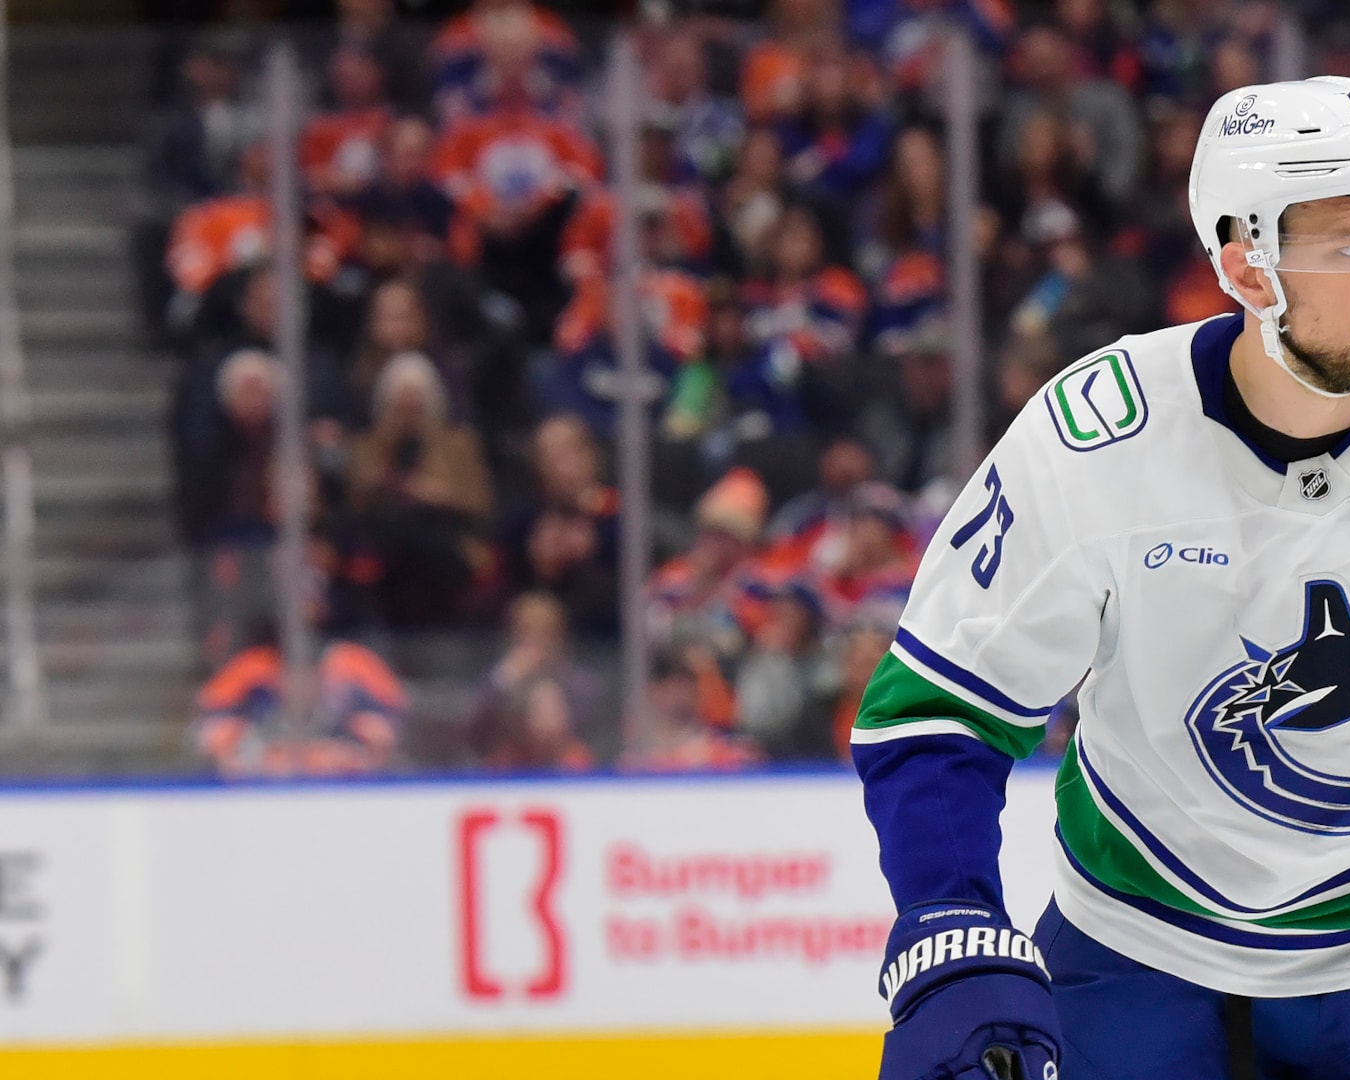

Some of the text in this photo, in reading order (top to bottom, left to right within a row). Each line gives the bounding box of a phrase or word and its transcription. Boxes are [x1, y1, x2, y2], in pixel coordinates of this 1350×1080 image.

[1218, 113, 1276, 137] NexGen
[950, 462, 1014, 589] 73
[1178, 547, 1229, 566] Clio
[606, 843, 832, 901] Bumper
[606, 905, 893, 967] to Bumper
[919, 908, 991, 923] DESHARNAIS
